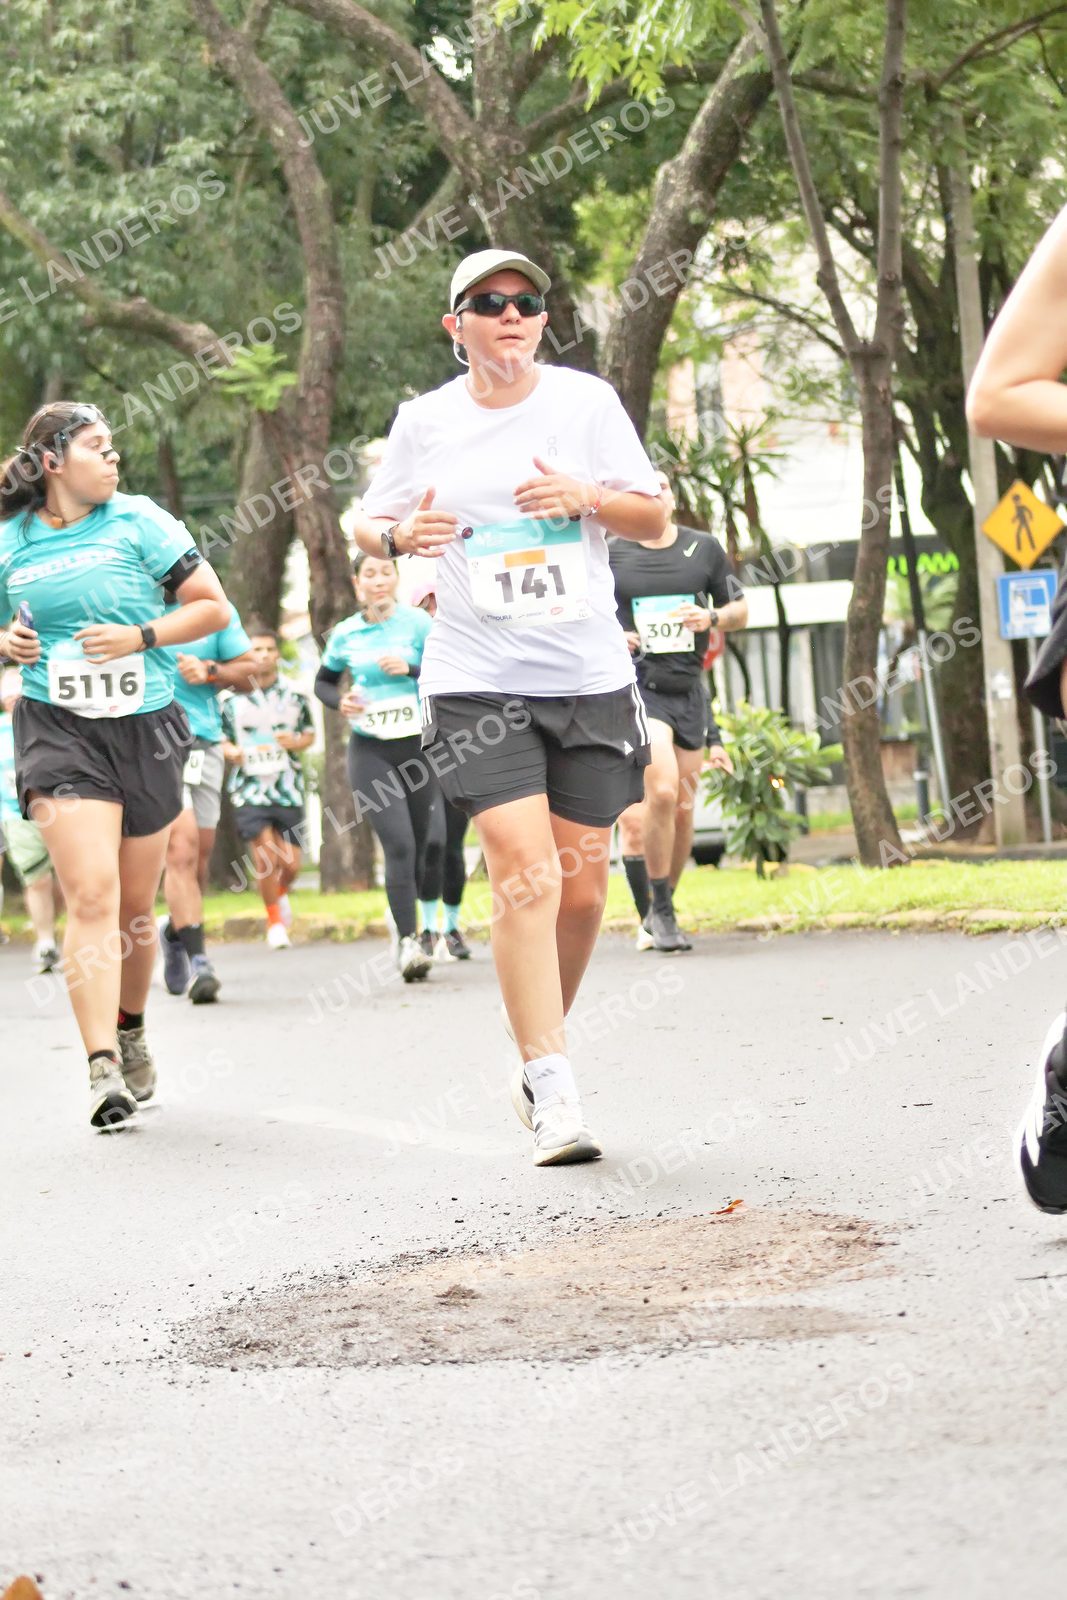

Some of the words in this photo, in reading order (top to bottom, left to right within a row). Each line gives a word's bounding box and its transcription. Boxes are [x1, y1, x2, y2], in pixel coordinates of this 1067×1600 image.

[494, 564, 566, 604] 141
[647, 622, 684, 638] 307
[58, 671, 139, 700] 5116
[366, 706, 414, 728] 3779
